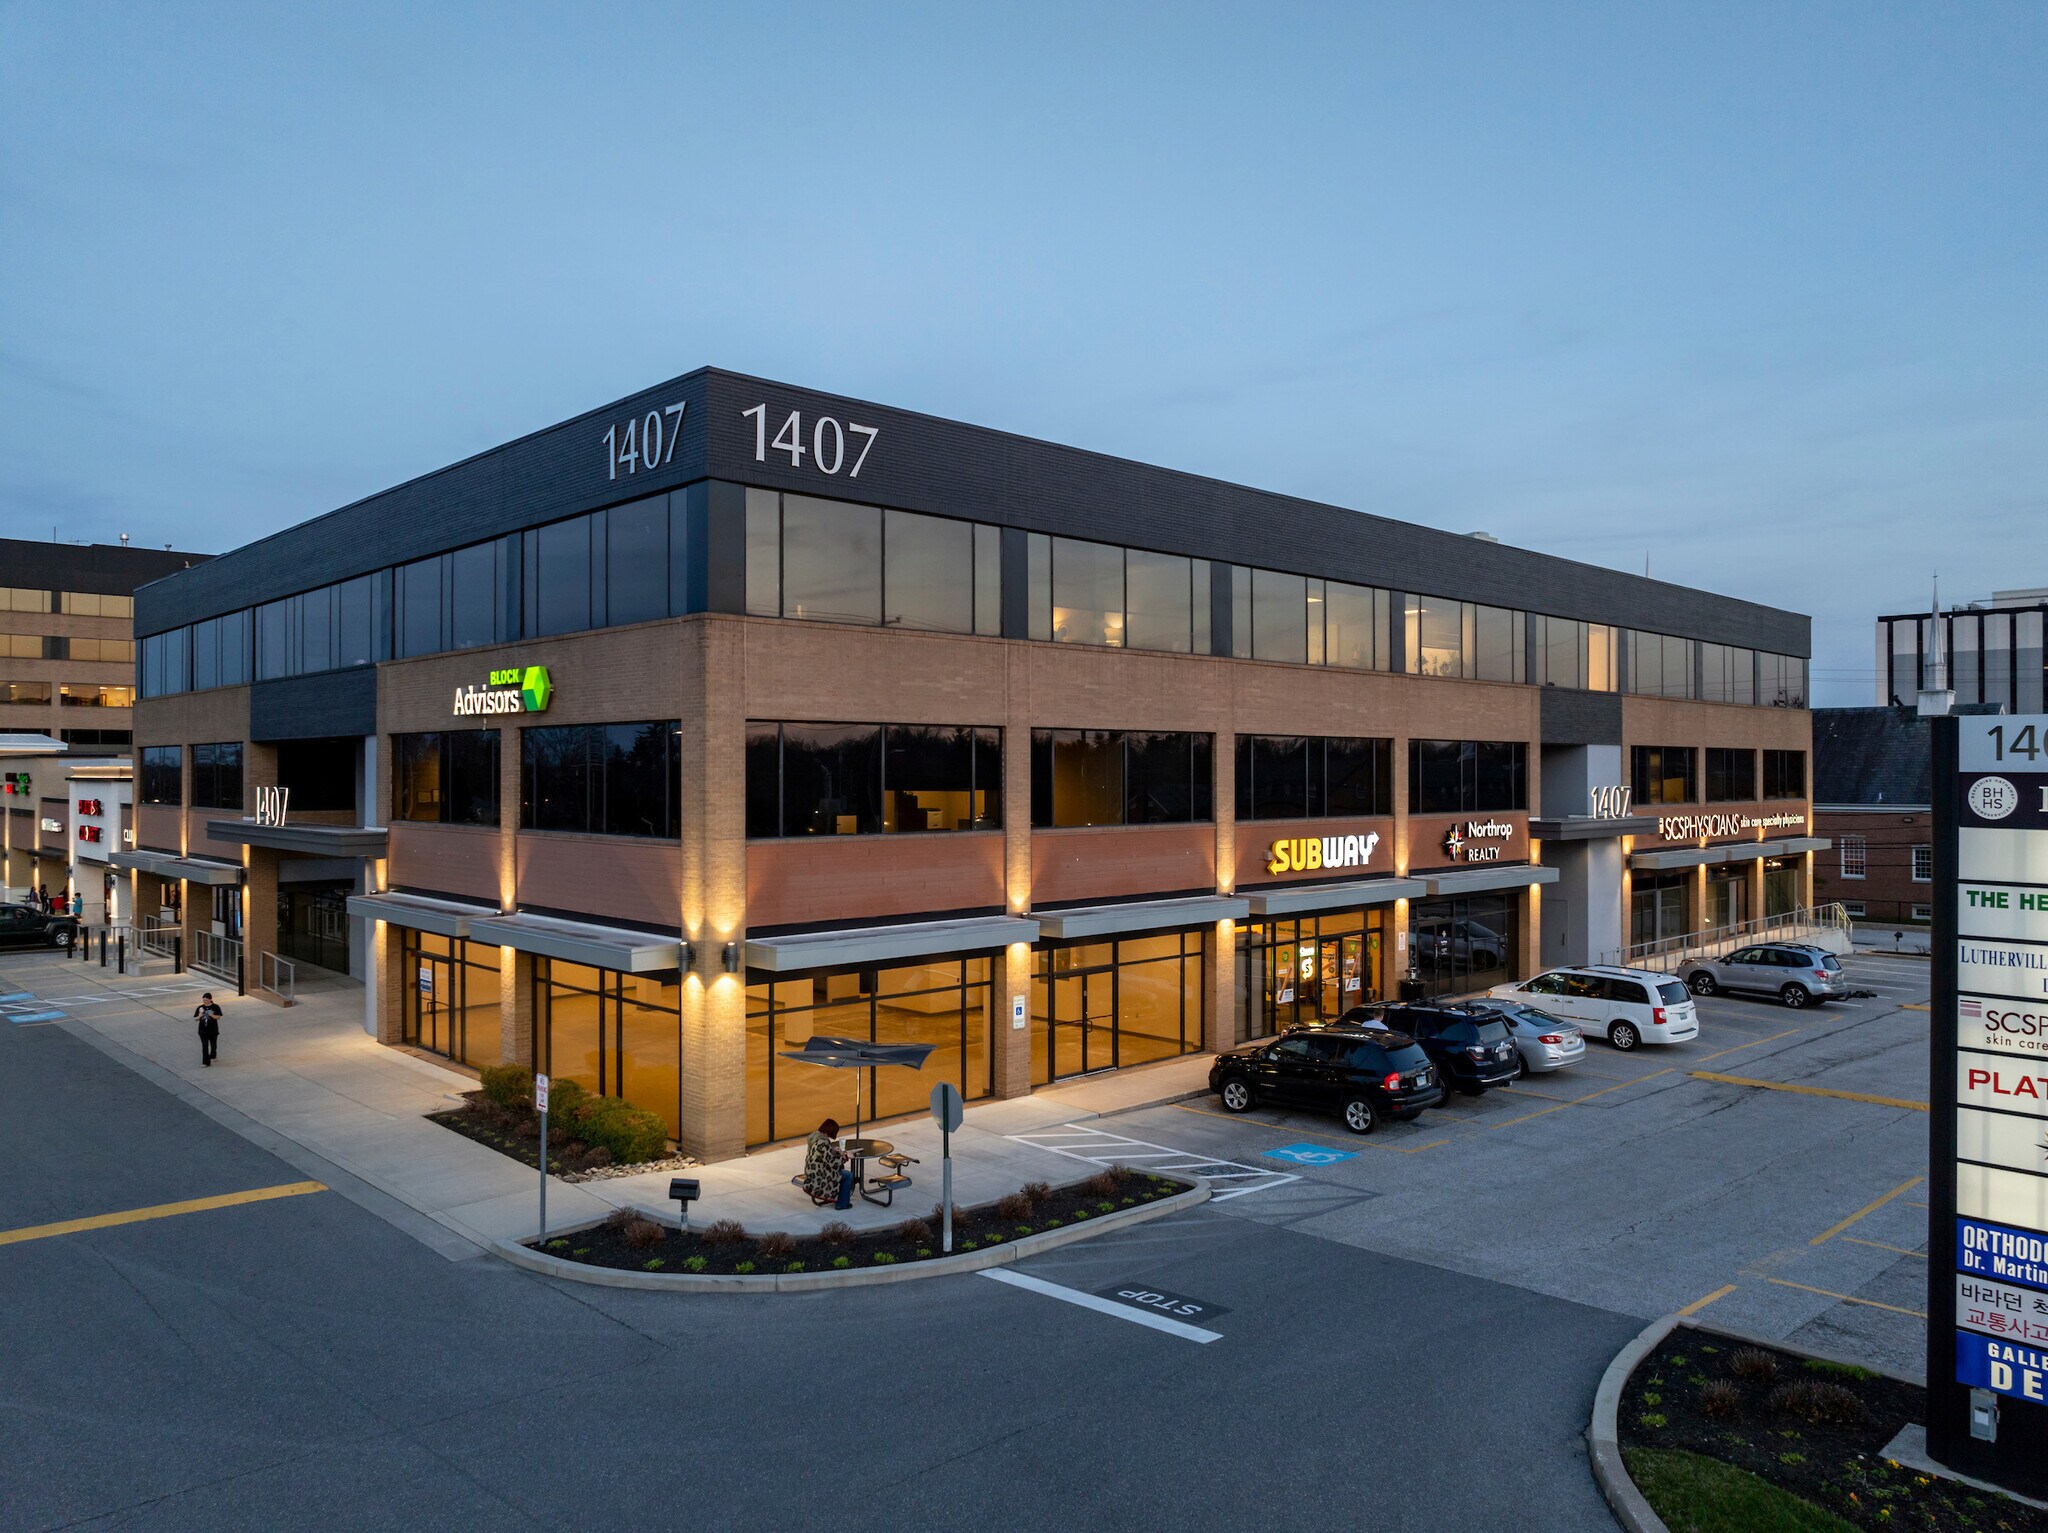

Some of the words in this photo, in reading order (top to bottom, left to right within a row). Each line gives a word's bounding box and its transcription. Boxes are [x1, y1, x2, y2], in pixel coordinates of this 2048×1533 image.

[602, 400, 687, 481] 1407
[741, 402, 879, 478] 1407
[490, 669, 520, 686] BLOCK
[453, 684, 520, 716] Advisors
[1987, 725, 2048, 761] 14
[256, 786, 289, 827] 1407
[1591, 785, 1632, 819] 1407
[1468, 820, 1513, 840] Northrop
[1665, 813, 1740, 841] SCSPHYSICIANS
[1267, 831, 1380, 876] SUBWAY
[1468, 846, 1500, 862] REALTY
[1966, 890, 2009, 909] THE
[1986, 1033, 2012, 1046] skin
[1964, 1249, 1985, 1270] Dr.
[1118, 1290, 1203, 1315] STOP
[1961, 1283, 2022, 1313] 바라던
[1966, 1308, 2048, 1342] 교통사고
